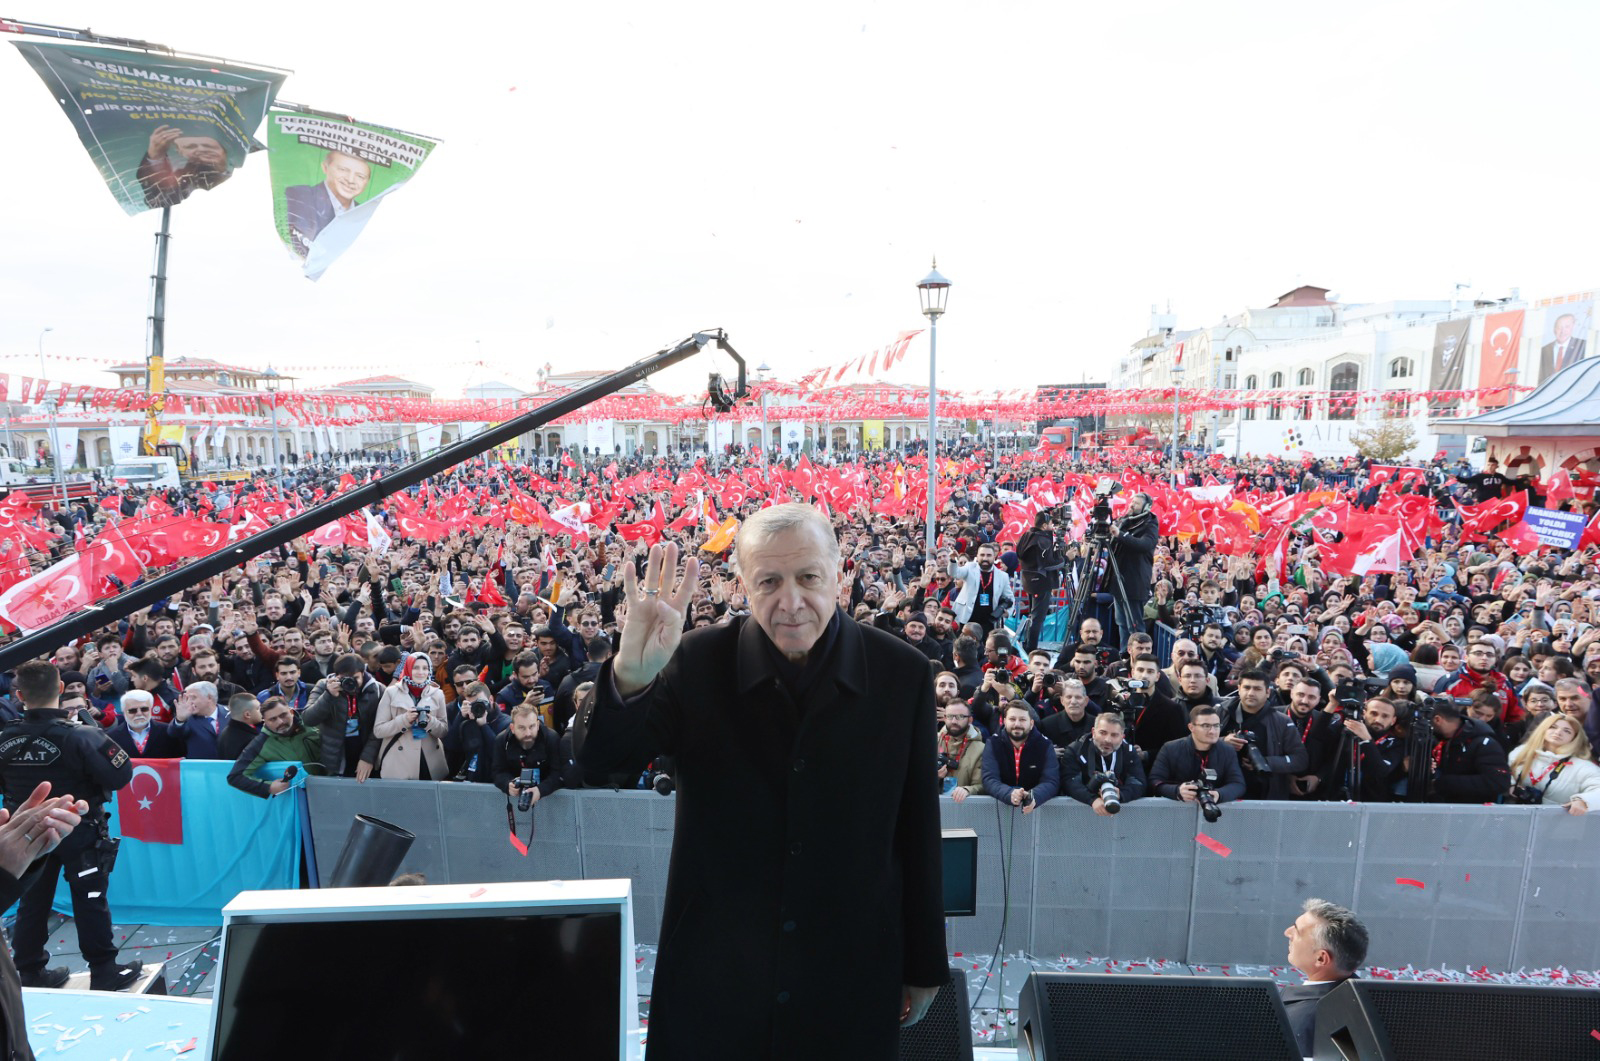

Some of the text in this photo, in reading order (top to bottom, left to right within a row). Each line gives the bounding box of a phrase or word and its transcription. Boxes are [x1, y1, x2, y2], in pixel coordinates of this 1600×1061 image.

[278, 116, 424, 157] DERDİMİN DERMANI
[285, 125, 414, 165] YARININ FERMANI
[359, 150, 391, 166] SEN.
[1538, 518, 1567, 530] YOLDA
